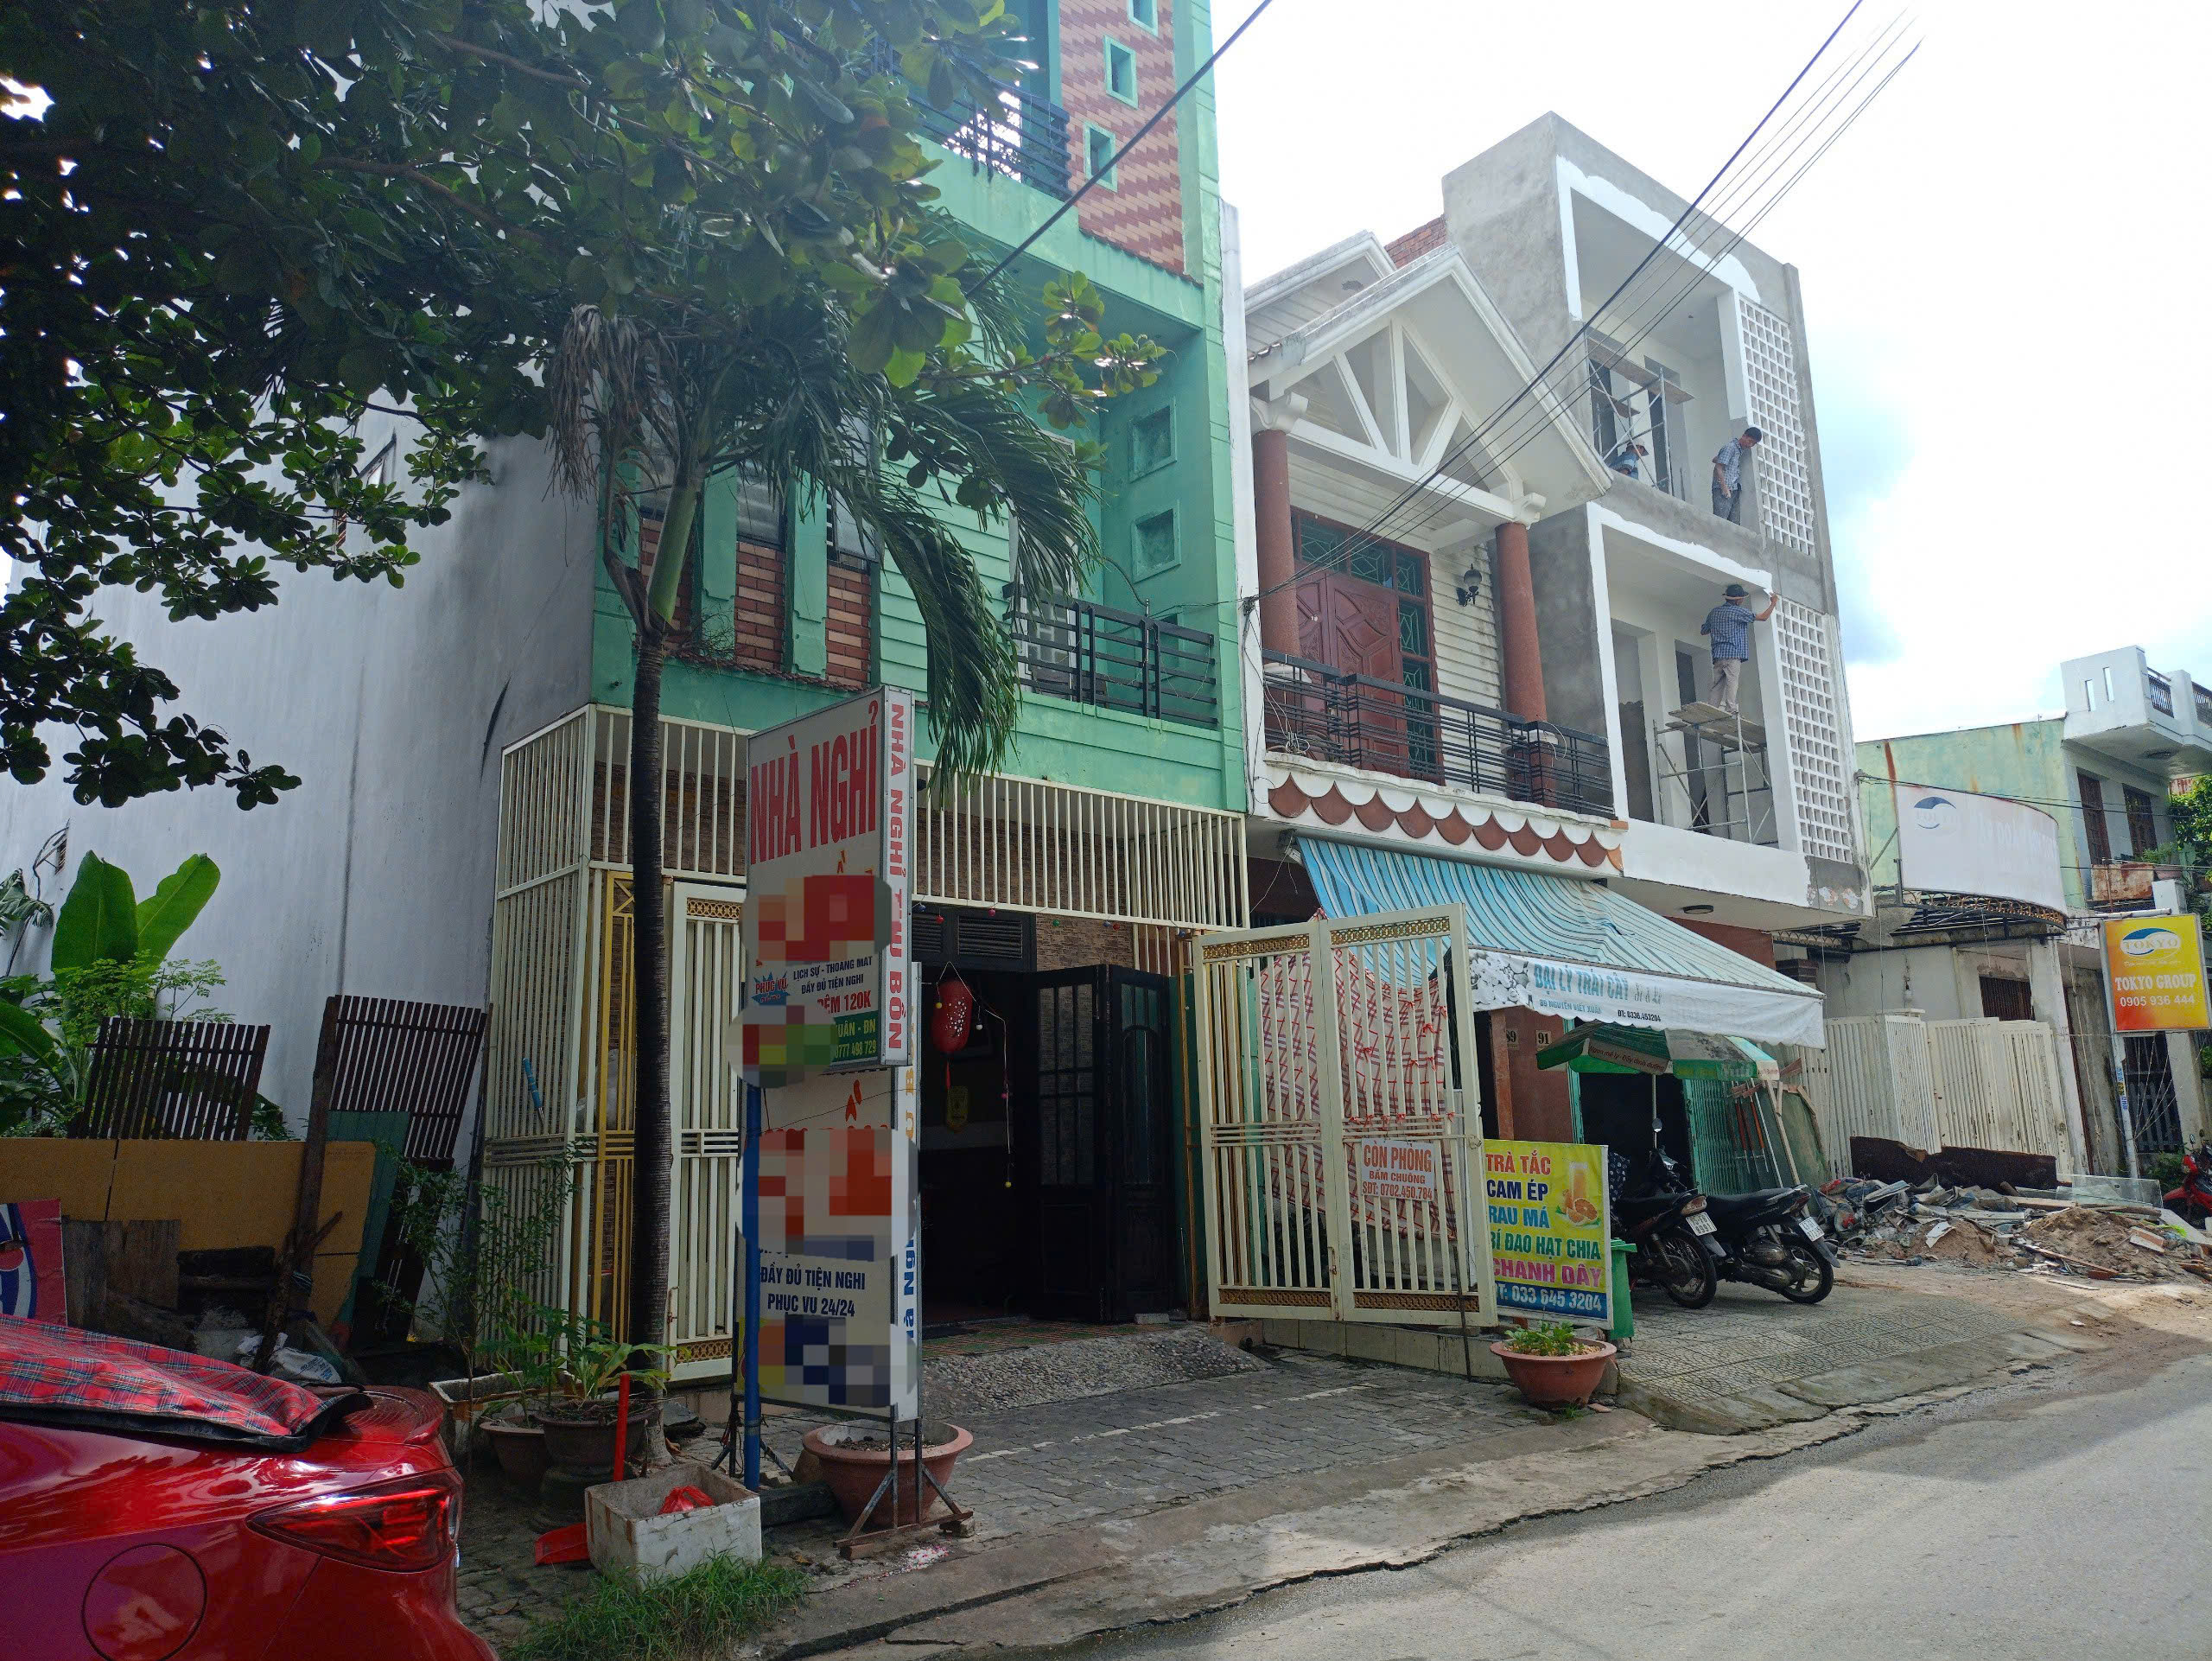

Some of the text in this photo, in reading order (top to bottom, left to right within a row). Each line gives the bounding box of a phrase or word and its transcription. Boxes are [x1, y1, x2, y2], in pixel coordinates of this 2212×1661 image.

[890, 703, 906, 777] NHÀ
[751, 700, 879, 865] NHÀ NGHỈ
[890, 789, 906, 878] NGHỈ
[2122, 939, 2178, 950] TOKYO
[793, 969, 809, 981] LỊCH
[810, 964, 821, 978] SỰ
[845, 973, 864, 986] NGHI
[1534, 964, 1556, 995] ĐẠI
[1575, 969, 1605, 996] TRÁI
[1606, 971, 1629, 1001] CÂY
[2115, 974, 2196, 991] TOKYO GROUP
[844, 990, 872, 1011] 120K
[889, 971, 906, 1049] BỒN
[2120, 995, 2195, 1008] 0905 936 444
[836, 1021, 855, 1037] UÂN
[863, 1019, 876, 1034] BN
[1538, 1032, 1550, 1045] 91
[865, 1040, 877, 1054] 729
[1363, 1140, 1432, 1173] CÒN PHÒNG
[1486, 1150, 1552, 1175] TRÀ TẮC
[1390, 1172, 1426, 1184] CHUÔNG
[1380, 1183, 1433, 1200] 0702.450.784
[1487, 1179, 1548, 1201] CAM ÉP
[1488, 1205, 1550, 1229] RAU MÁ
[1504, 1232, 1532, 1253] ĐAO
[1535, 1236, 1563, 1260] HẠT
[1567, 1239, 1602, 1260] CHIA
[760, 1261, 866, 1291] ĐẦY ĐỦ TIỆN NGHI
[1492, 1257, 1603, 1288] CHANH DÂY
[821, 1298, 855, 1317] 24/24
[1511, 1285, 1536, 1303] 033
[1540, 1289, 1566, 1307] 645
[1569, 1292, 1602, 1312] 3204
